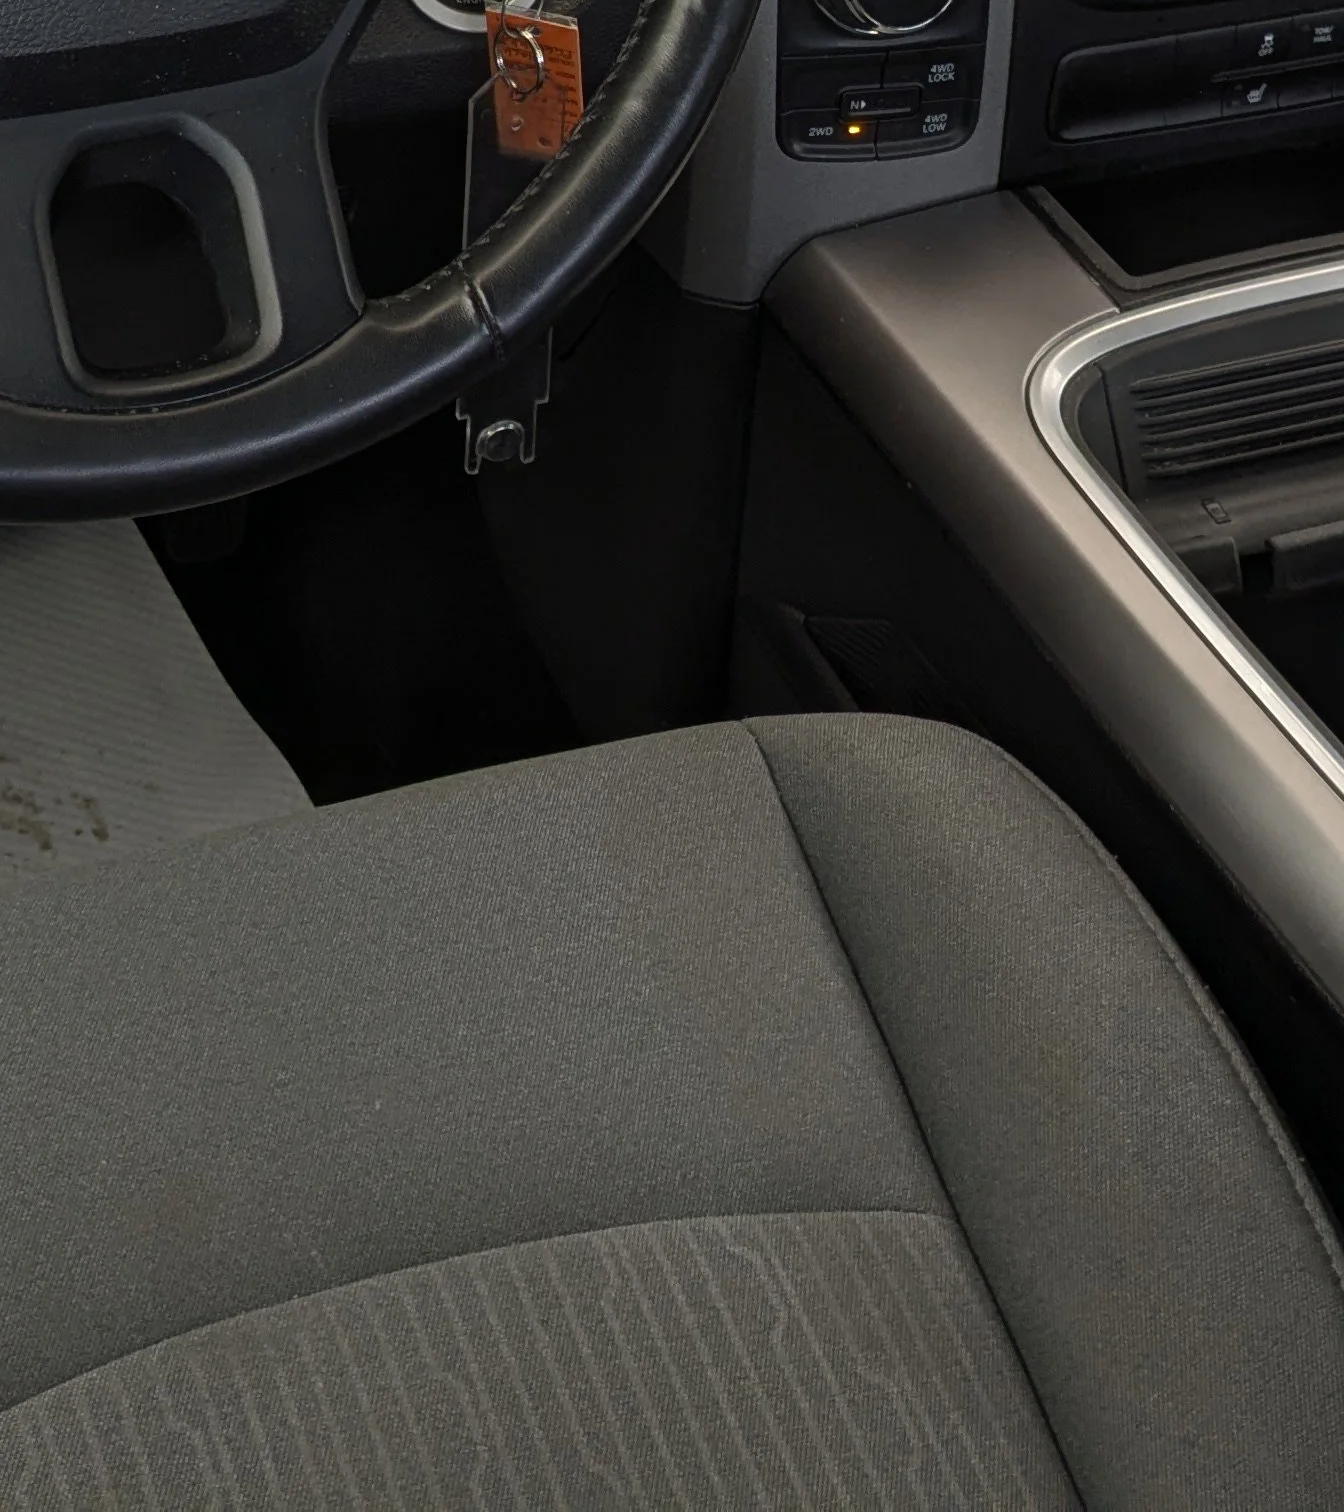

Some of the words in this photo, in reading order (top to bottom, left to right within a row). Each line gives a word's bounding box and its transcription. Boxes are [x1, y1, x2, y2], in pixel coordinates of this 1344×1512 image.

[929, 62, 955, 74] 4WD
[928, 70, 956, 83] LOCK
[924, 113, 948, 124] 4WD
[808, 126, 834, 137] 2WD
[922, 121, 947, 133] LOW
